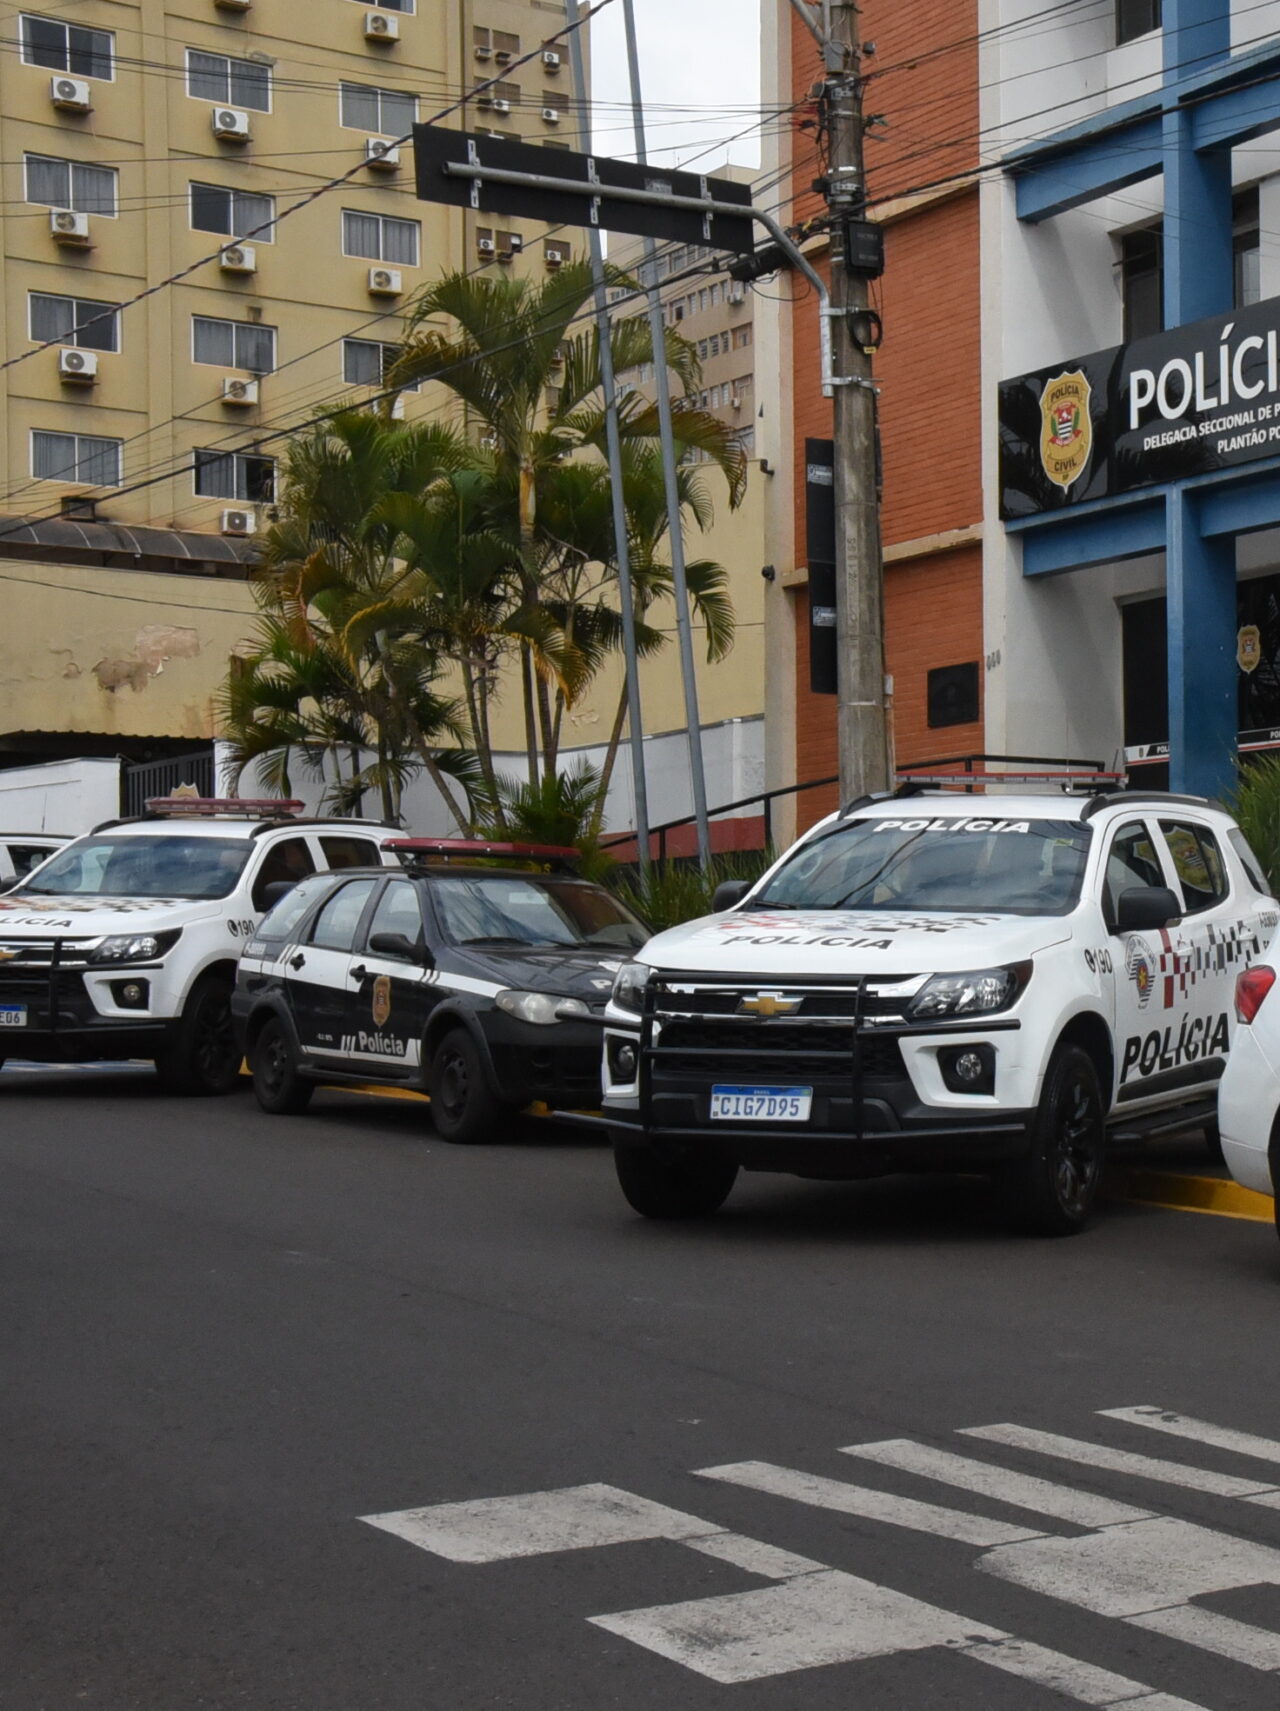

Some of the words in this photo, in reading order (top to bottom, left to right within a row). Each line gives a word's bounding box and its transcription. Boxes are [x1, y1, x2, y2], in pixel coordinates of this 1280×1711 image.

[1050, 384, 1080, 402] POLÍCIA
[1143, 423, 1198, 451] DELEGACIA
[1198, 408, 1256, 436] SECCIONAL
[1258, 404, 1272, 421] DE
[1217, 428, 1267, 454] PLANTÃO
[1054, 457, 1077, 472] CIVIL
[873, 817, 1031, 834] POLÍCIA
[720, 935, 894, 950] POLÍCIA
[1093, 949, 1113, 974] 190
[358, 1030, 405, 1055] Polícia
[1119, 1012, 1231, 1084] POLÍCIA
[720, 1097, 800, 1117] CIG7D95
